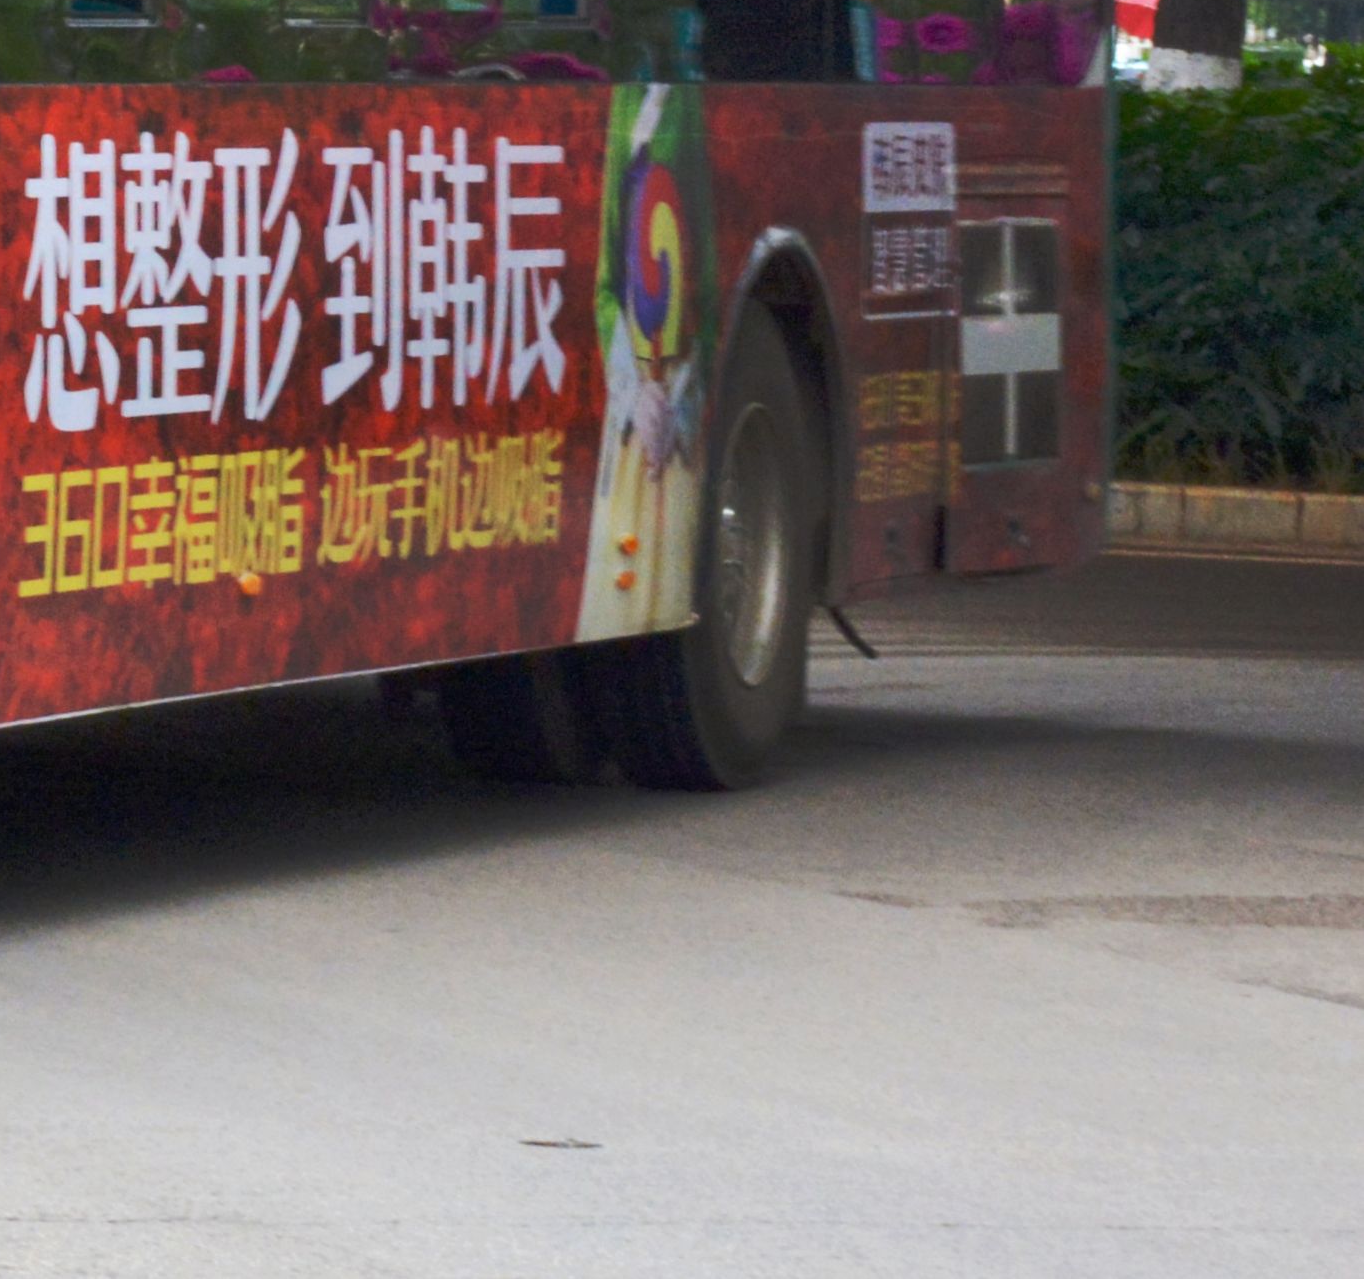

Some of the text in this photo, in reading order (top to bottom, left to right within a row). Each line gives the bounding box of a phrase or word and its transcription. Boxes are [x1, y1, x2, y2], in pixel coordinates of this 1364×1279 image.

[23, 125, 566, 432] 想整形 到韩辰
